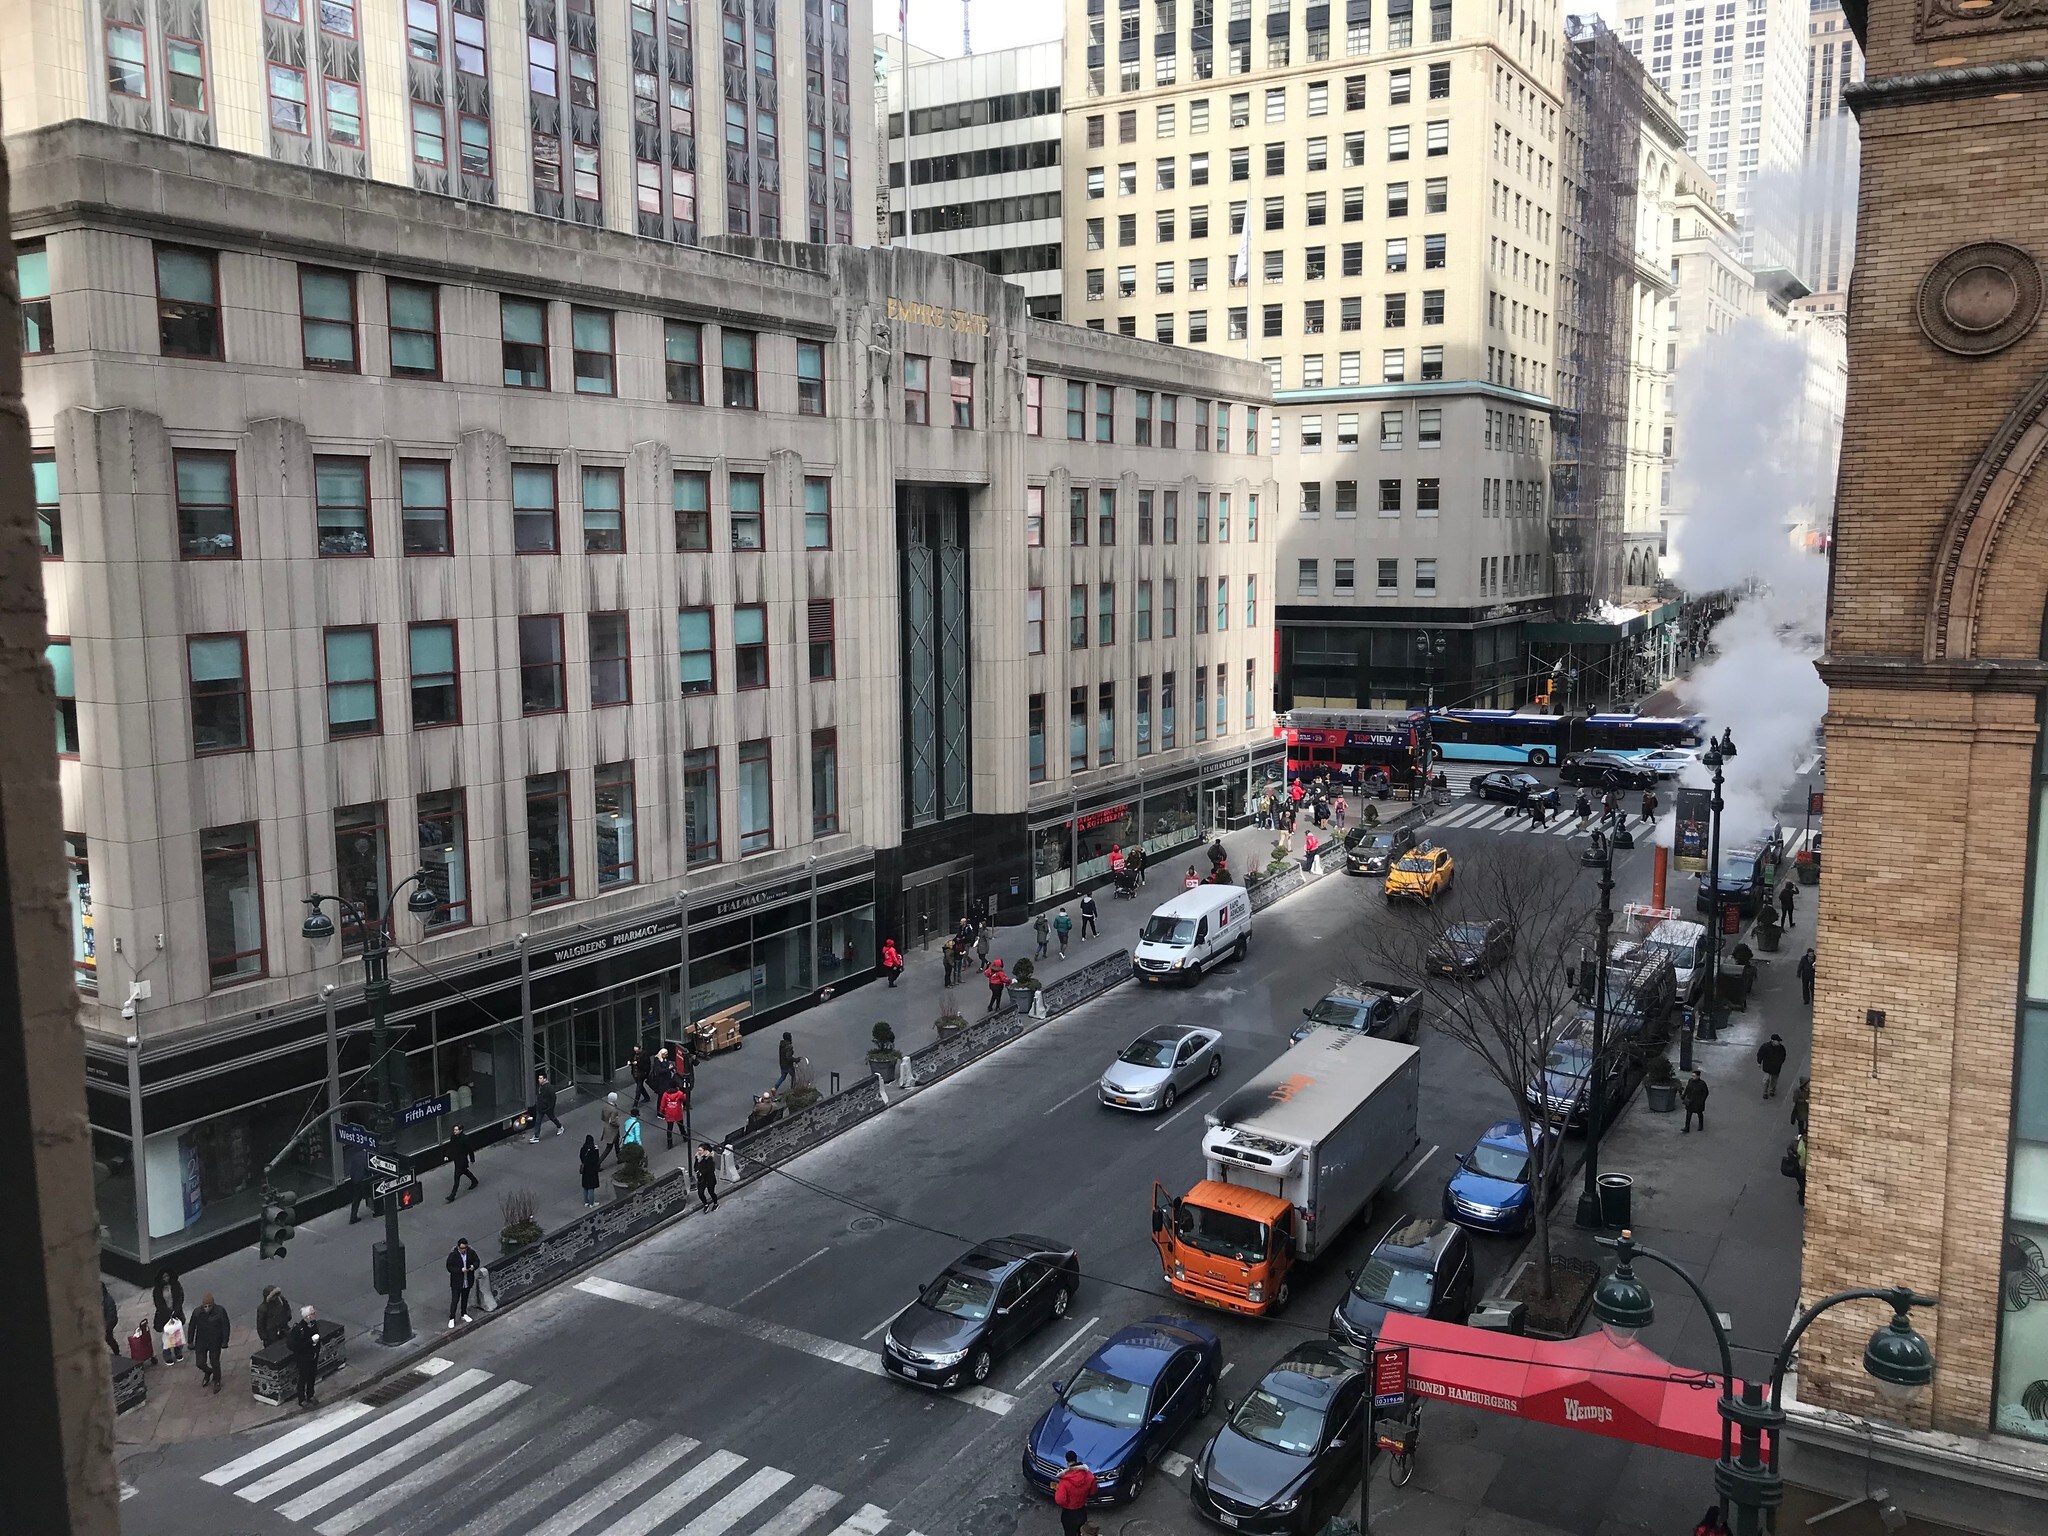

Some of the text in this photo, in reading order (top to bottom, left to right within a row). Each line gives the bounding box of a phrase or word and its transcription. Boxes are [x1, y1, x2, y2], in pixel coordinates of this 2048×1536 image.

[887, 296, 991, 337] EMPIRE STATE
[1354, 733, 1394, 743] TOPVIEW
[717, 892, 768, 915] PHARMACY
[554, 939, 607, 961] WALGREENS
[613, 924, 658, 945] PHARMACY
[405, 1109, 424, 1123] Fifth
[426, 1103, 442, 1115] Ave
[339, 1129, 376, 1148] West 33rd St
[385, 1161, 395, 1169] WAY
[1222, 1157, 1243, 1166] THERMO
[380, 1174, 409, 1192] ONE WAY
[1448, 1386, 1517, 1412] HAMBURGERS
[1563, 1397, 1613, 1423] Wendy's
